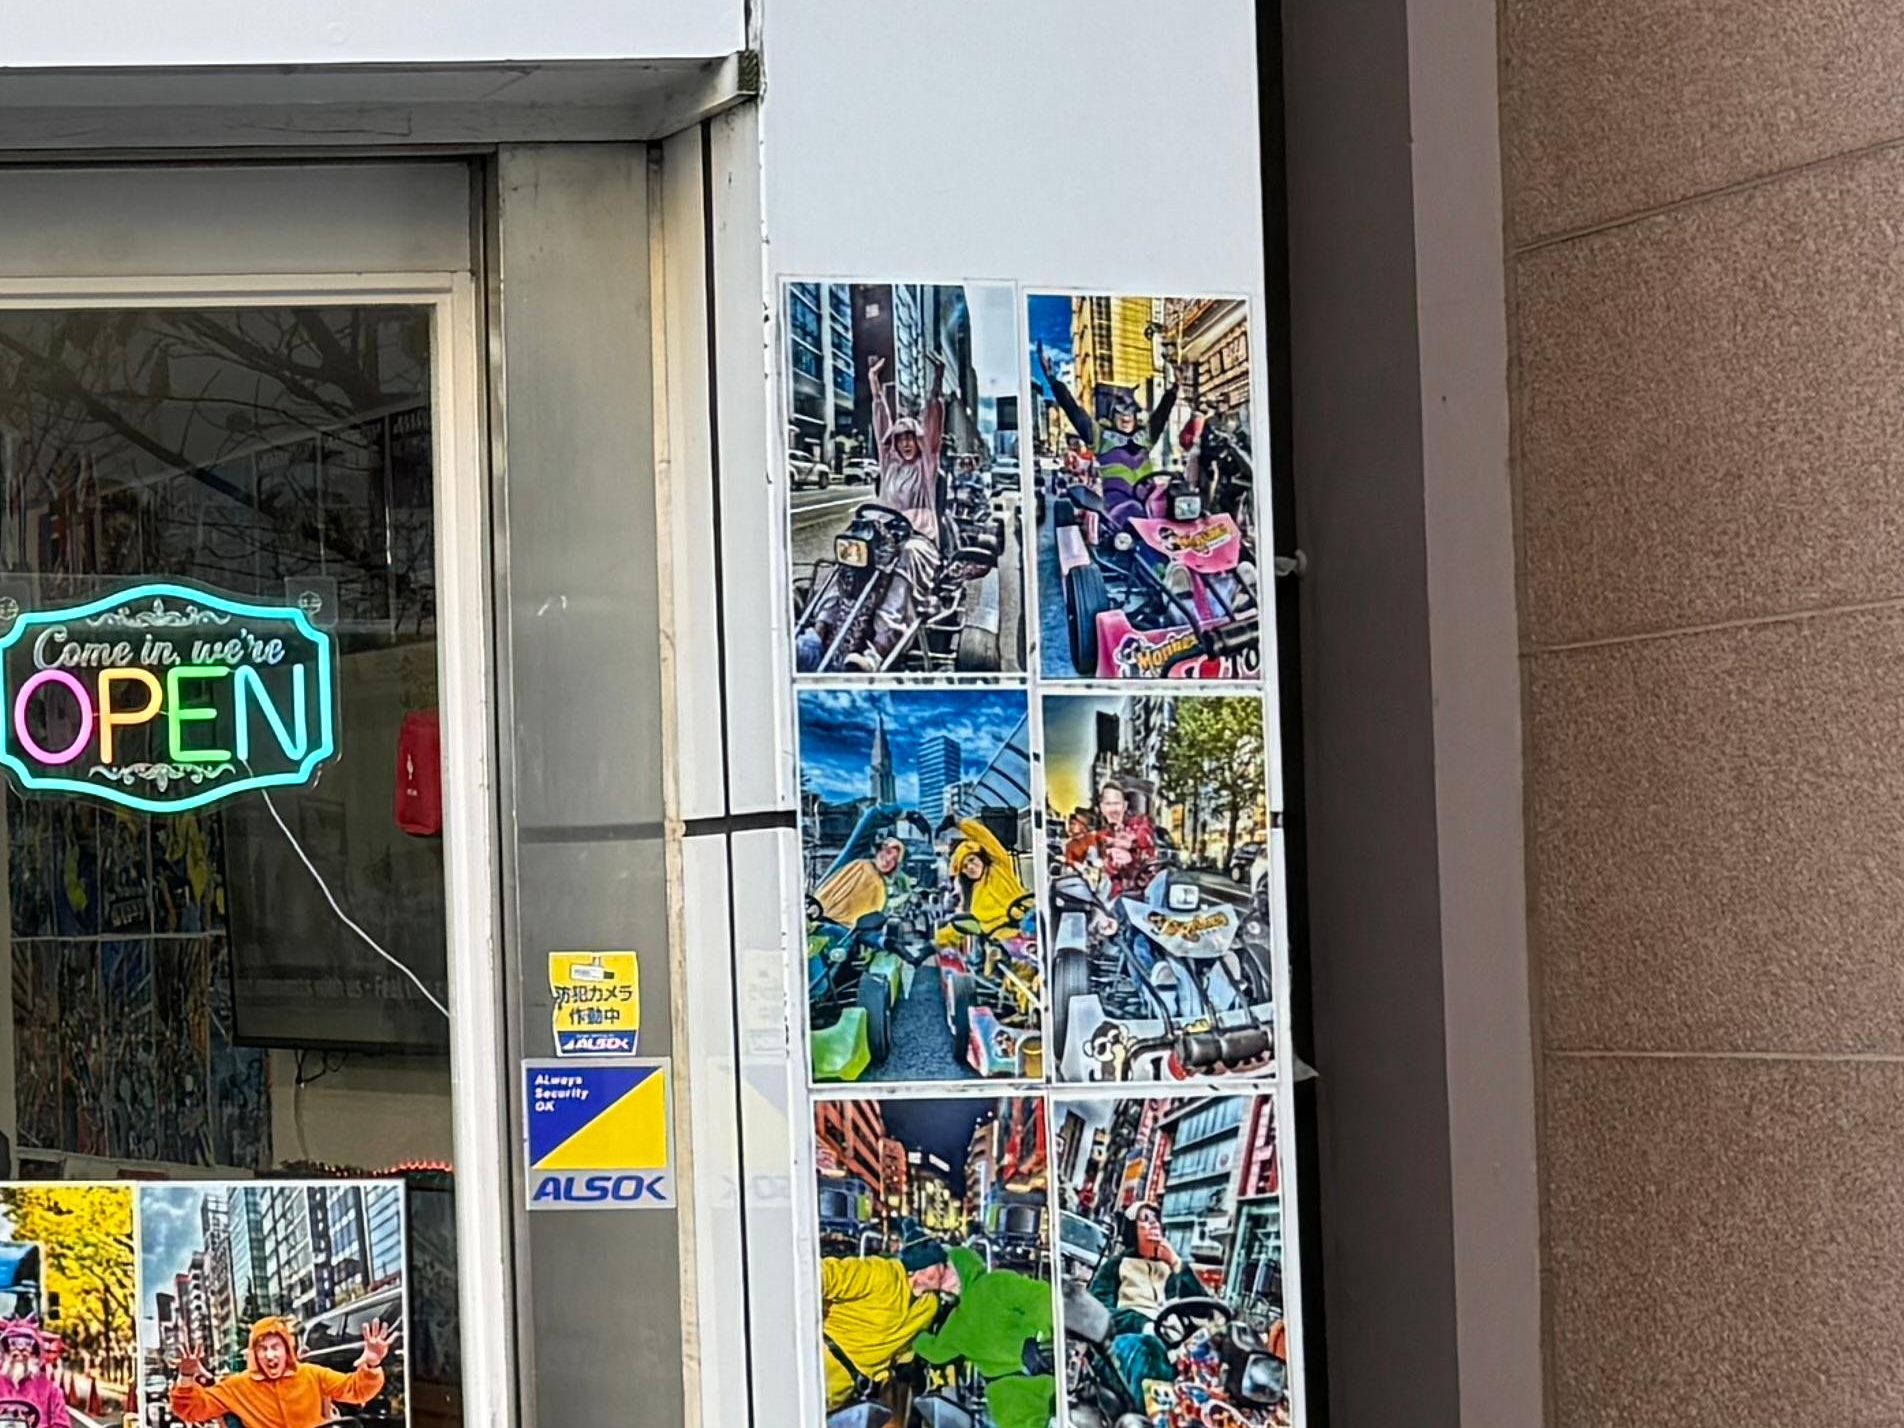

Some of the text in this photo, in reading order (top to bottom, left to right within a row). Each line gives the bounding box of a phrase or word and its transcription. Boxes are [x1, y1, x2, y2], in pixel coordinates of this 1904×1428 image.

[33, 626, 134, 669] Come
[192, 628, 285, 665] we're
[14, 663, 305, 766] OPEN
[554, 985, 633, 1004] 防犯カメラ
[569, 1008, 621, 1025] 作動中
[575, 1035, 630, 1050] ALSOK
[534, 1088, 589, 1101] Security
[535, 1101, 555, 1112] OK
[533, 1175, 667, 1201] ALSOK
